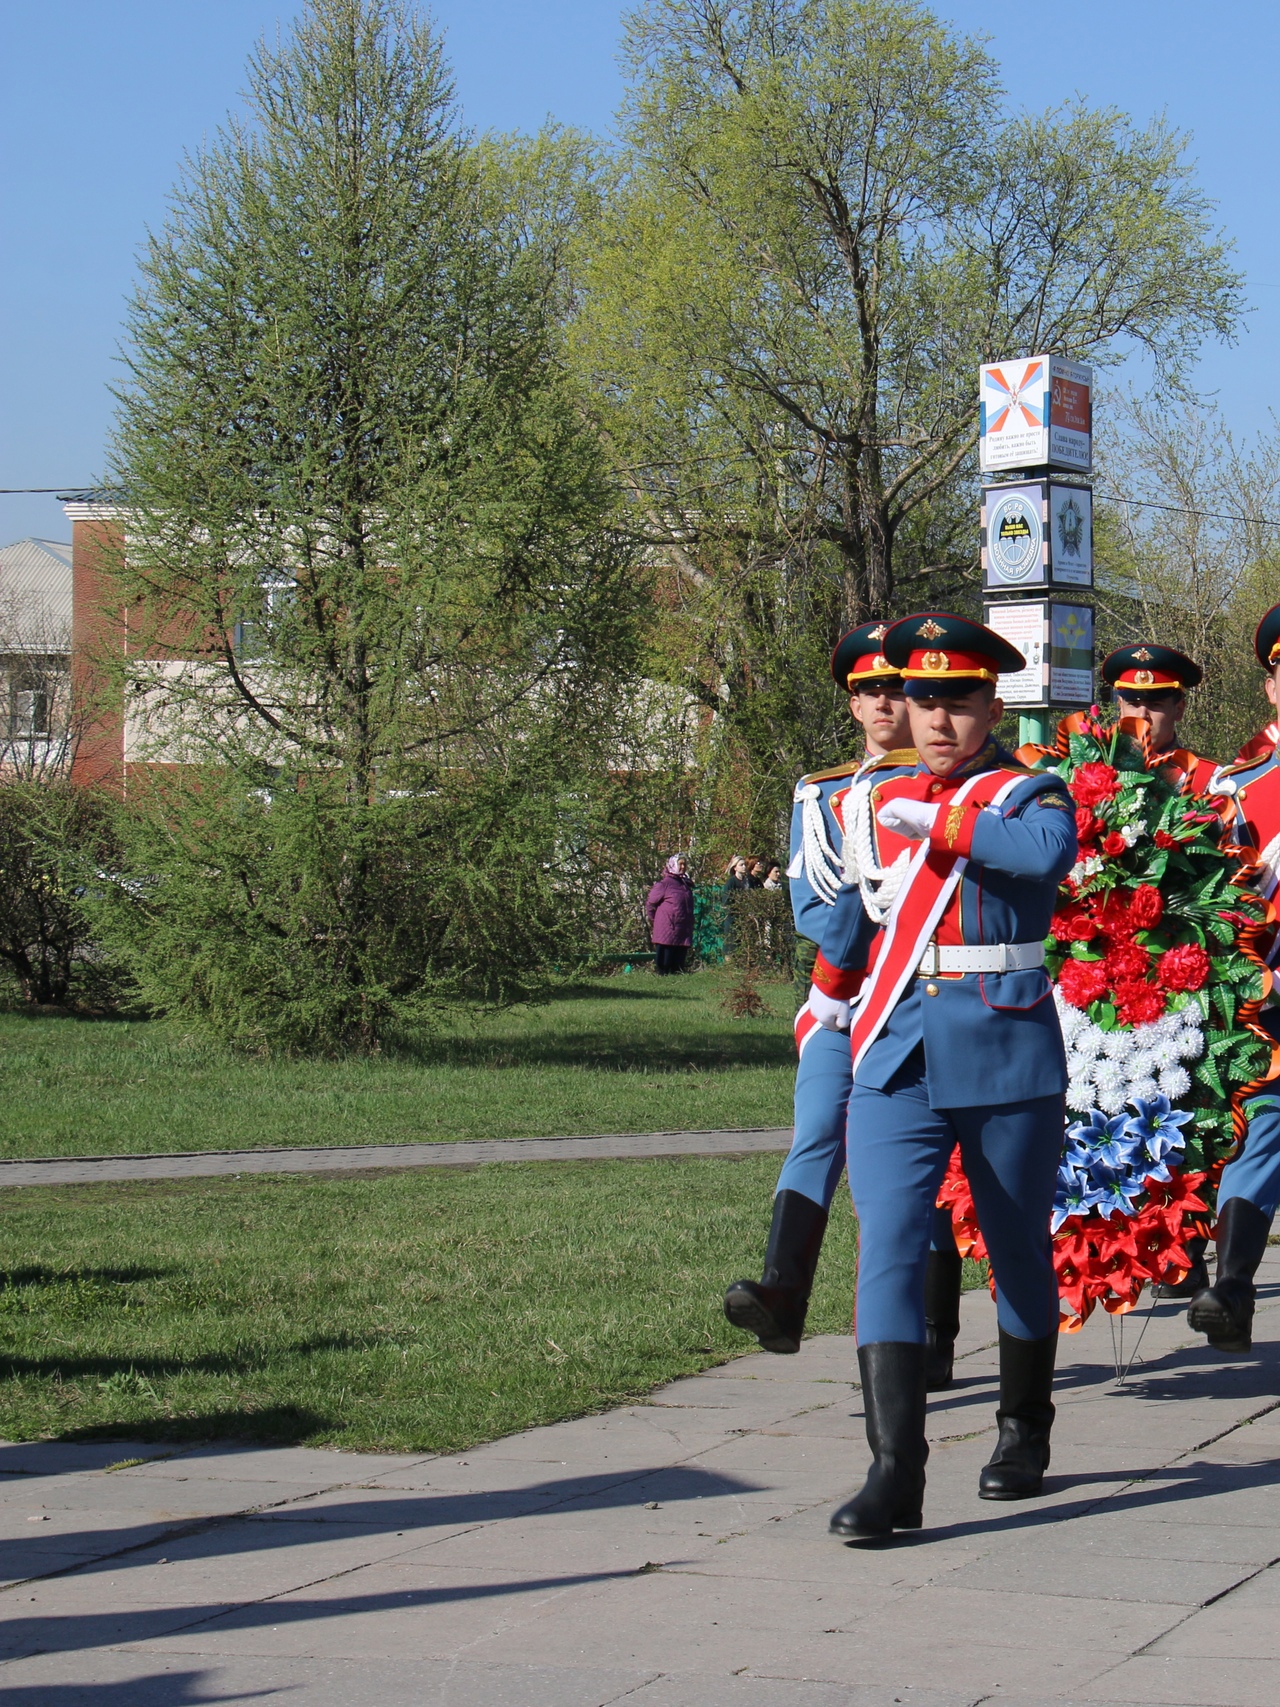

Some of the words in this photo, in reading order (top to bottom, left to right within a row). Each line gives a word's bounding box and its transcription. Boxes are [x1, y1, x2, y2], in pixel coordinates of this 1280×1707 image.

[1003, 505, 1012, 513] ВС
[1015, 503, 1024, 511] РФ
[993, 543, 1014, 575] ВОЕННАЯ
[1015, 538, 1037, 574] РАЗВЕДКА
